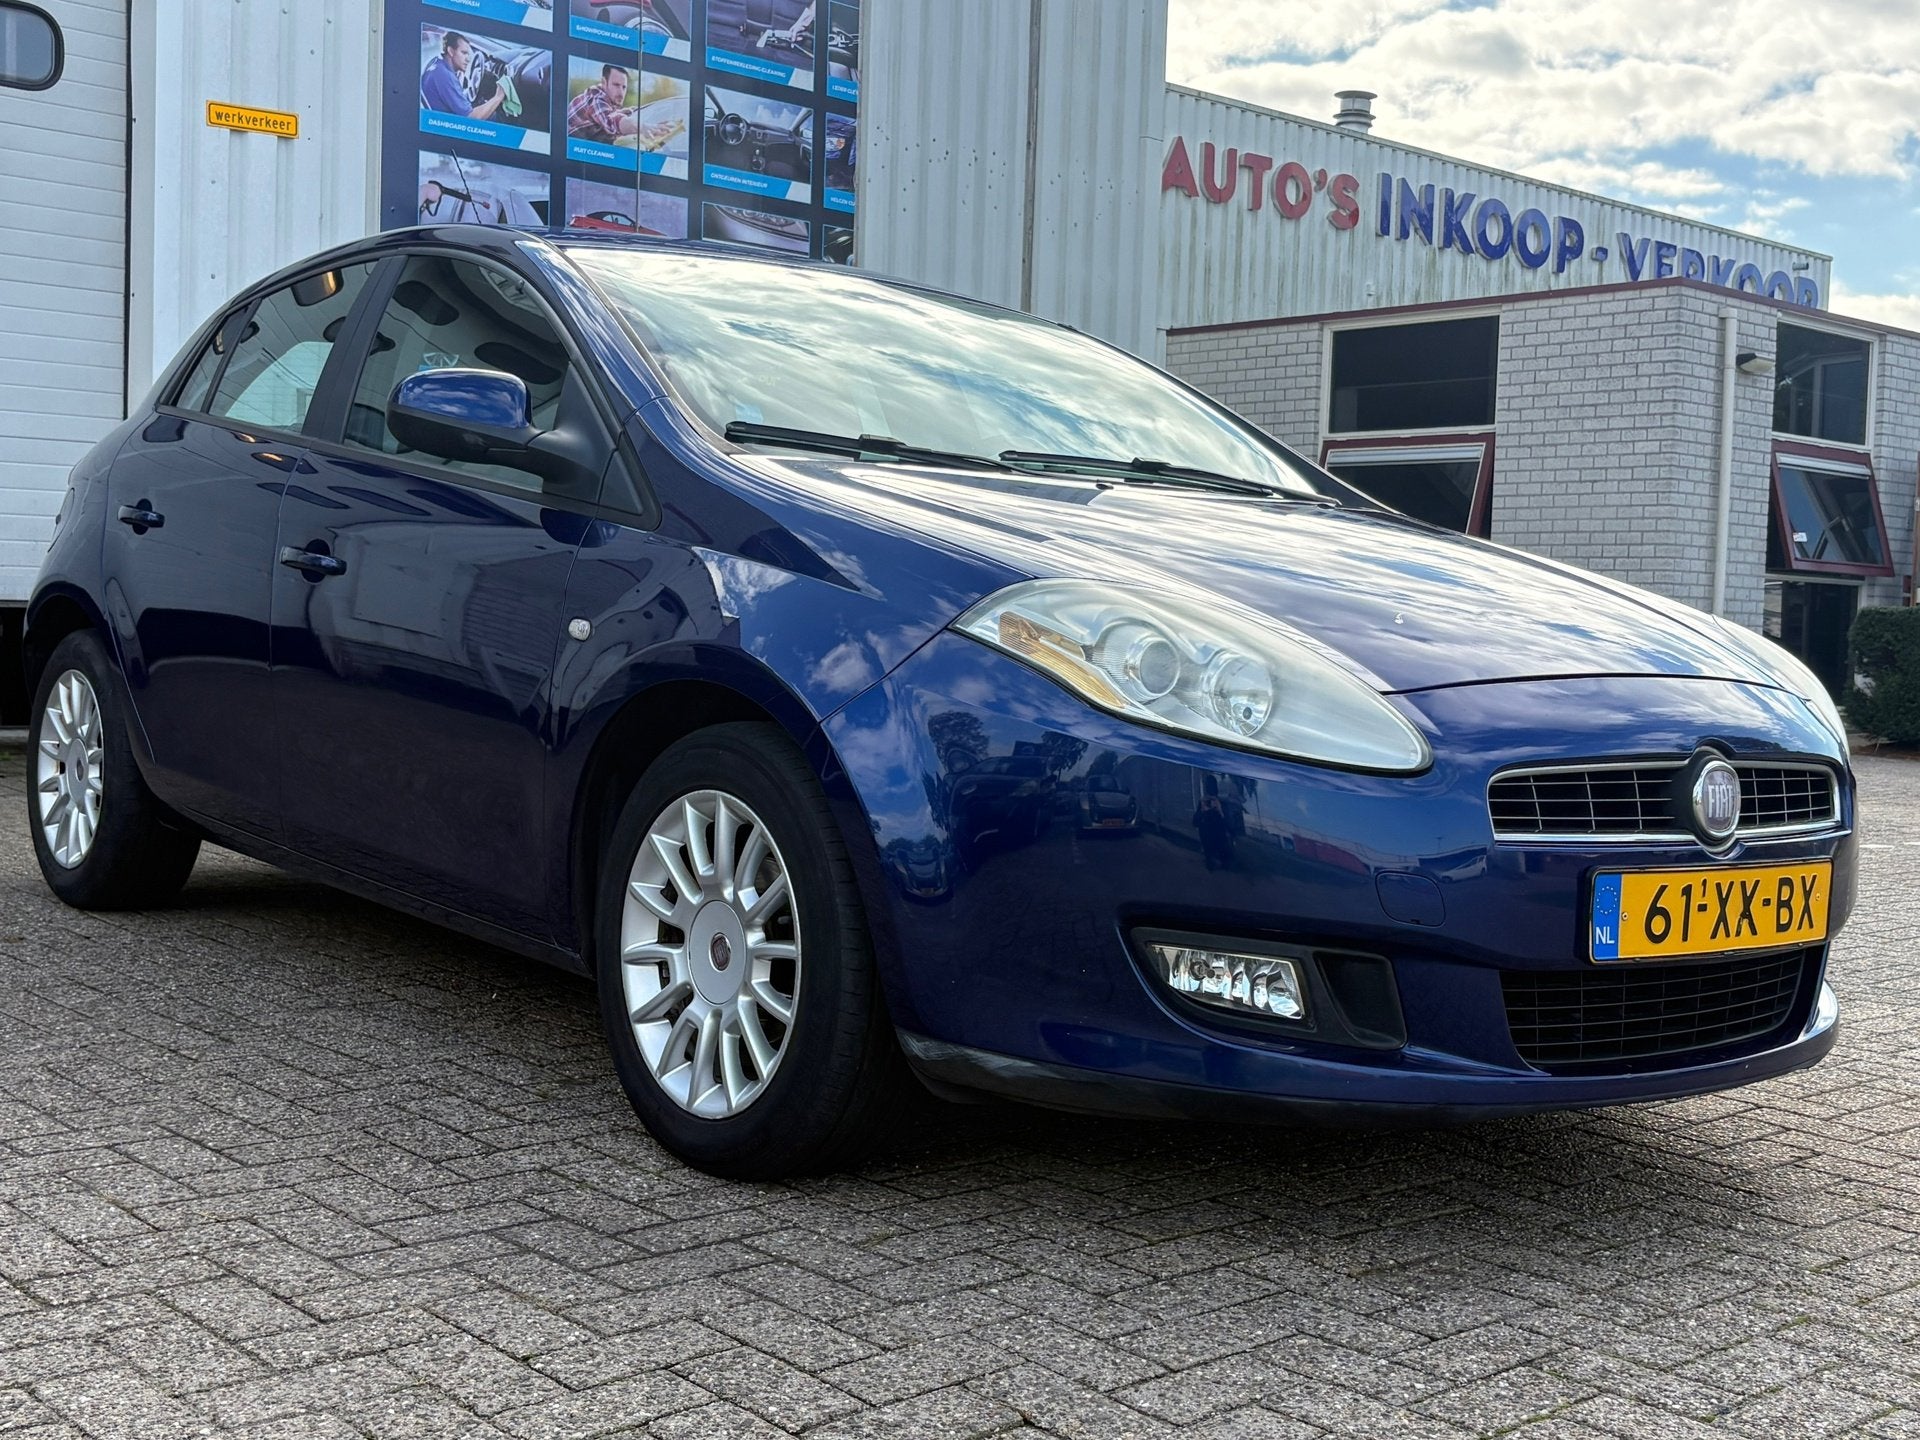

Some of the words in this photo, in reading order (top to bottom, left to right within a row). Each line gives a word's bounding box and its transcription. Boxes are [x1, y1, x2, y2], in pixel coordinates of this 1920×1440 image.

[575, 24, 611, 38] SHOWROOM
[214, 110, 292, 131] werkverkeer
[428, 118, 467, 132] DASHBOARD
[466, 125, 497, 138] CLEANING
[586, 148, 615, 160] CLEANING
[1161, 135, 1361, 231] AUTO'S
[1375, 171, 1585, 274] INKOOP
[1708, 783, 1734, 819] FIAT
[1595, 925, 1616, 945] NL
